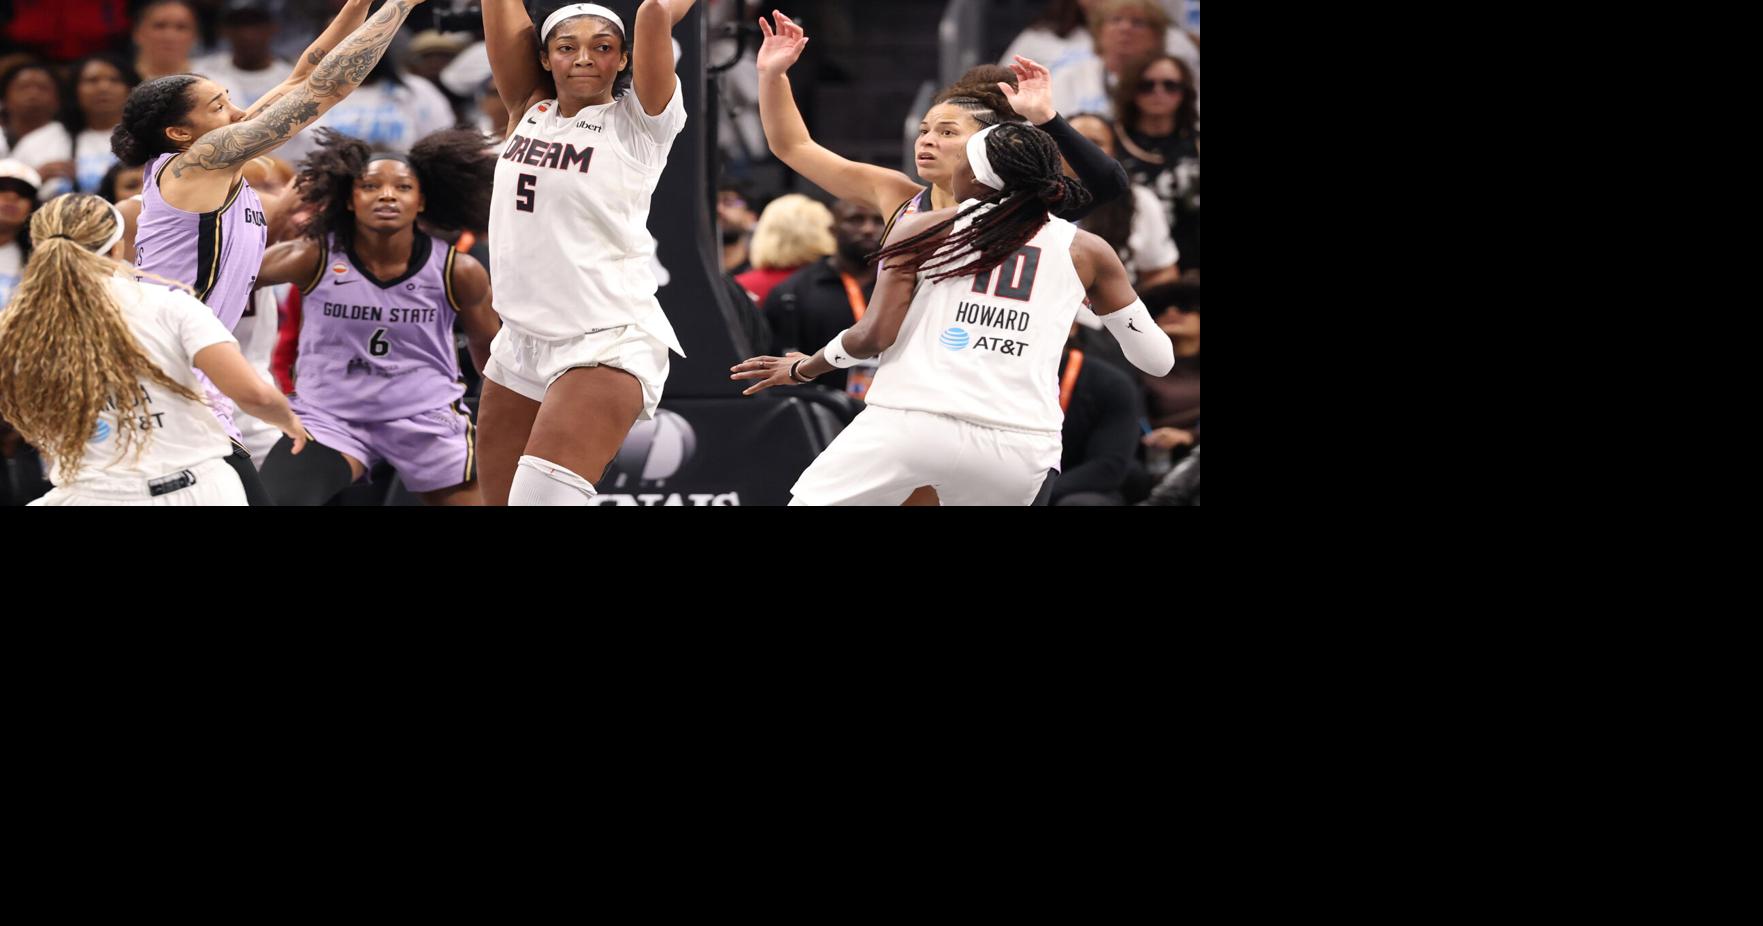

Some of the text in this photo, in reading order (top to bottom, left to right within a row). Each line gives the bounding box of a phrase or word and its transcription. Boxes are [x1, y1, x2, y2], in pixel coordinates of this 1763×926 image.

[502, 134, 595, 174] DREAM
[516, 173, 537, 213] 5
[323, 302, 437, 323] GOLDEN STATE
[955, 301, 1030, 332] HOWARD
[369, 328, 390, 356] 6
[973, 336, 1029, 357] AT&T
